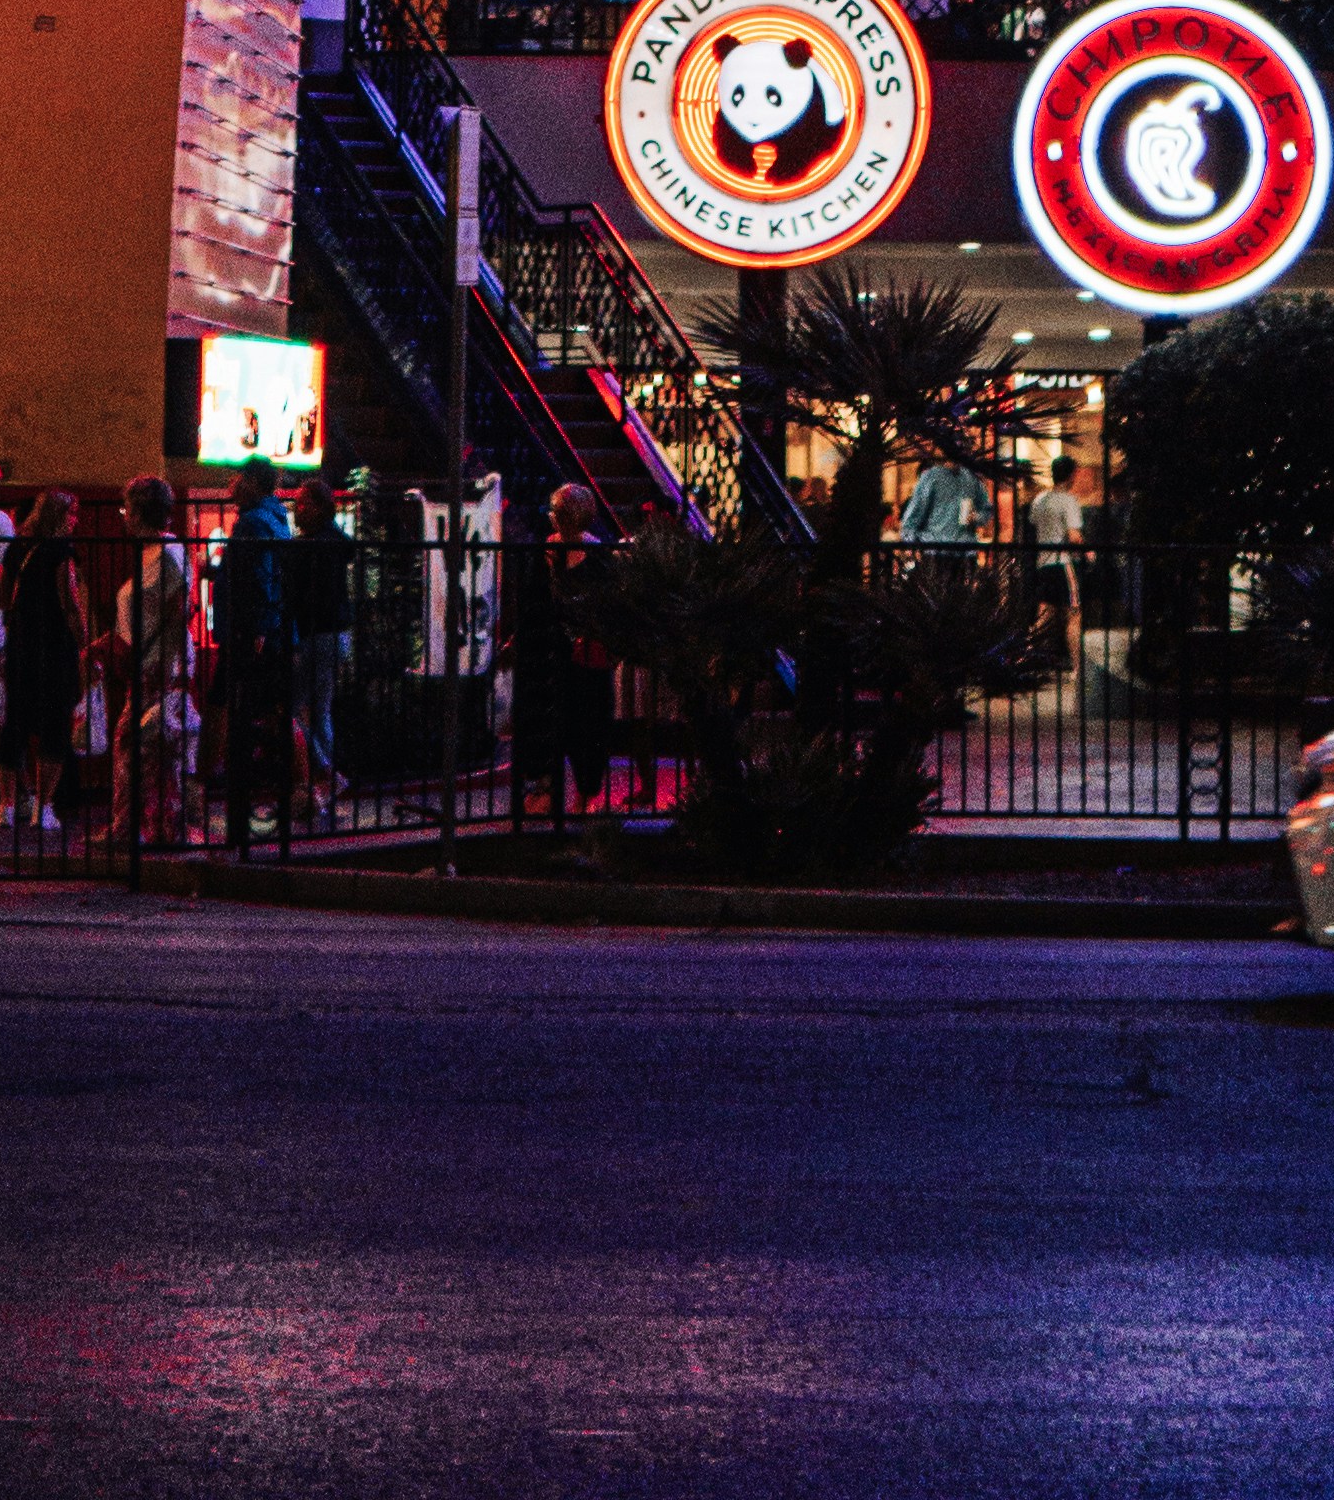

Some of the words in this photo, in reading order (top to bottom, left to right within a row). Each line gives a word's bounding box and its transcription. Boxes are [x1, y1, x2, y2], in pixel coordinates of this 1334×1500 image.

[1044, 14, 1300, 126] CHIPOTLE
[640, 137, 753, 239] CHINESE
[768, 150, 889, 240] KITCHEN
[1053, 177, 1201, 281] MEXICAN
[1210, 178, 1297, 270] GRILL
